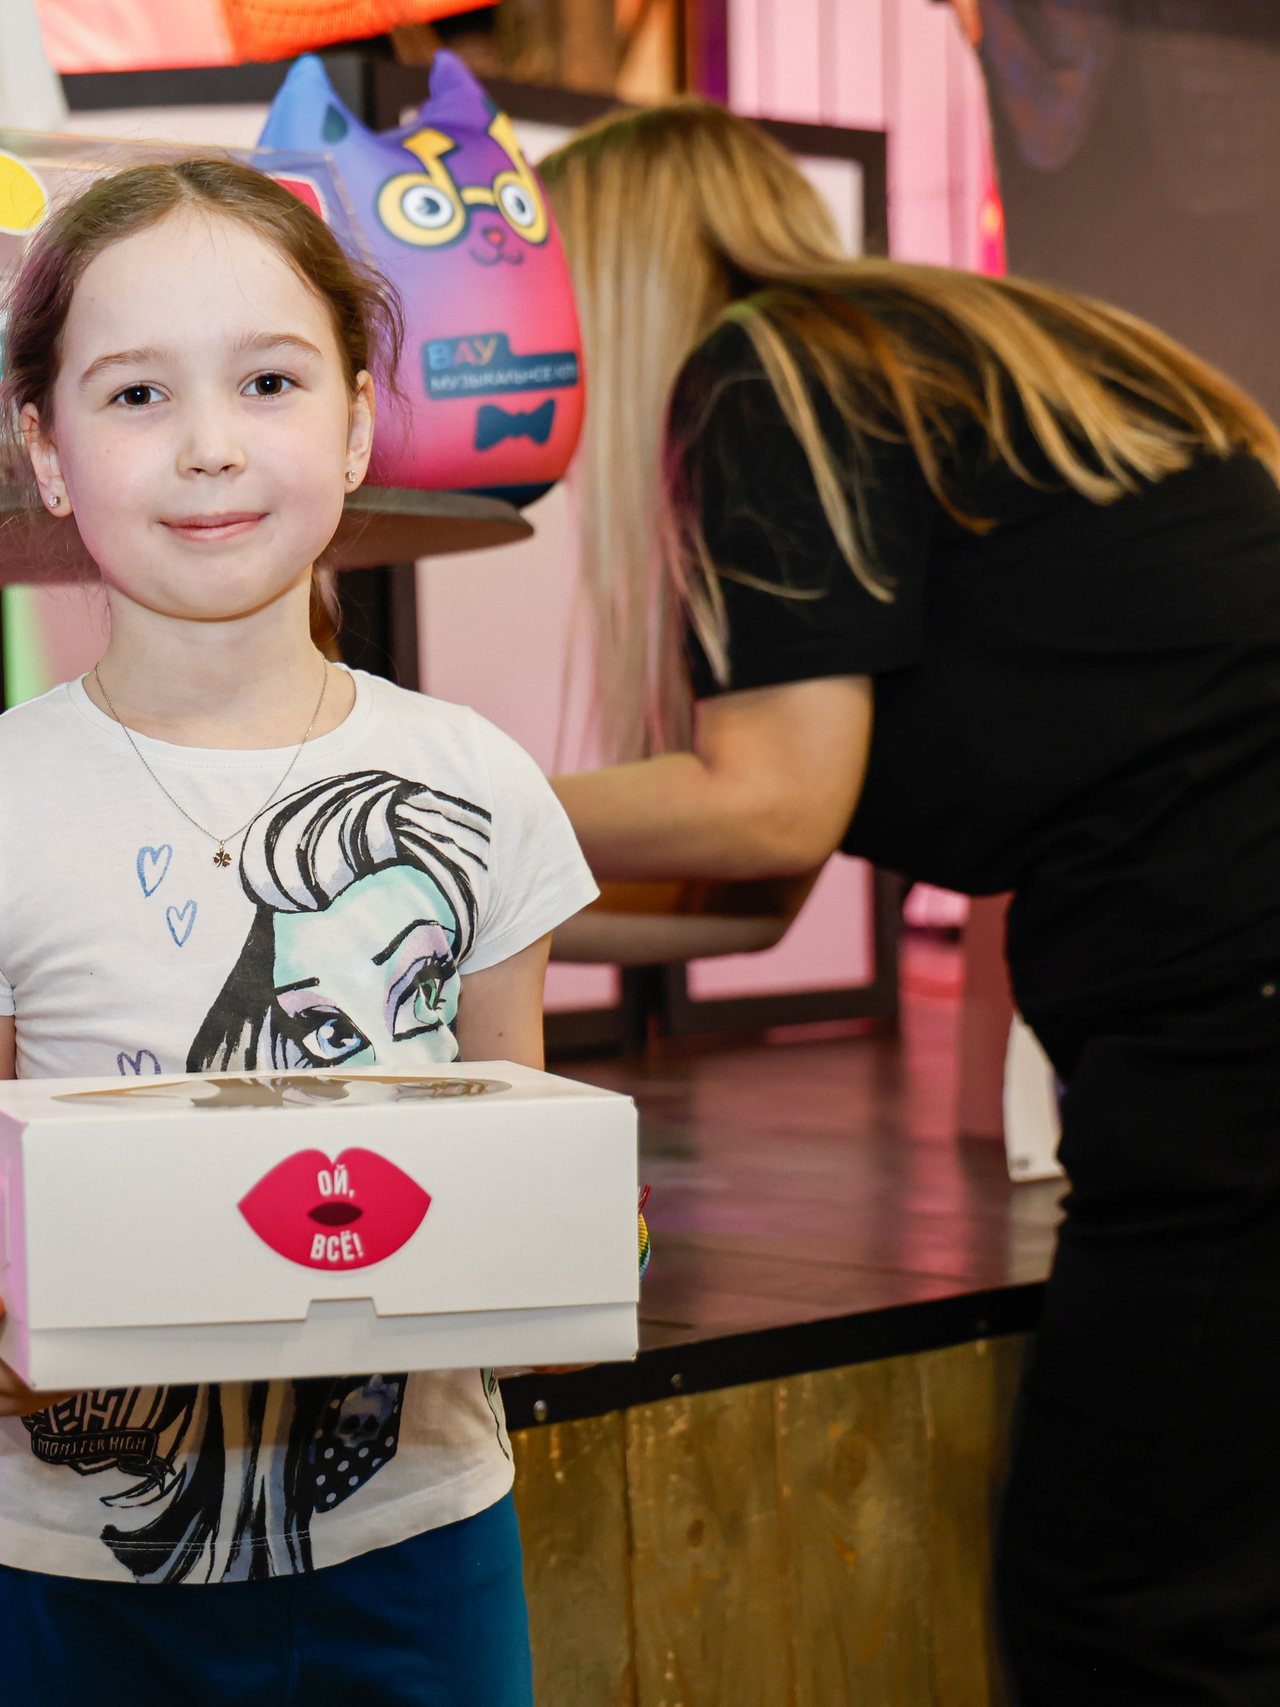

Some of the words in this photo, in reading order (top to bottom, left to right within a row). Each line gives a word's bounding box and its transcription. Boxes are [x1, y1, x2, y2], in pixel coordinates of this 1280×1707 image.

[427, 337, 498, 370] ВАУ
[317, 1164, 355, 1197] ОЙ,
[310, 1230, 364, 1262] ВСЁ!
[37, 1438, 105, 1457] MONSTER
[109, 1435, 147, 1451] HIGH
